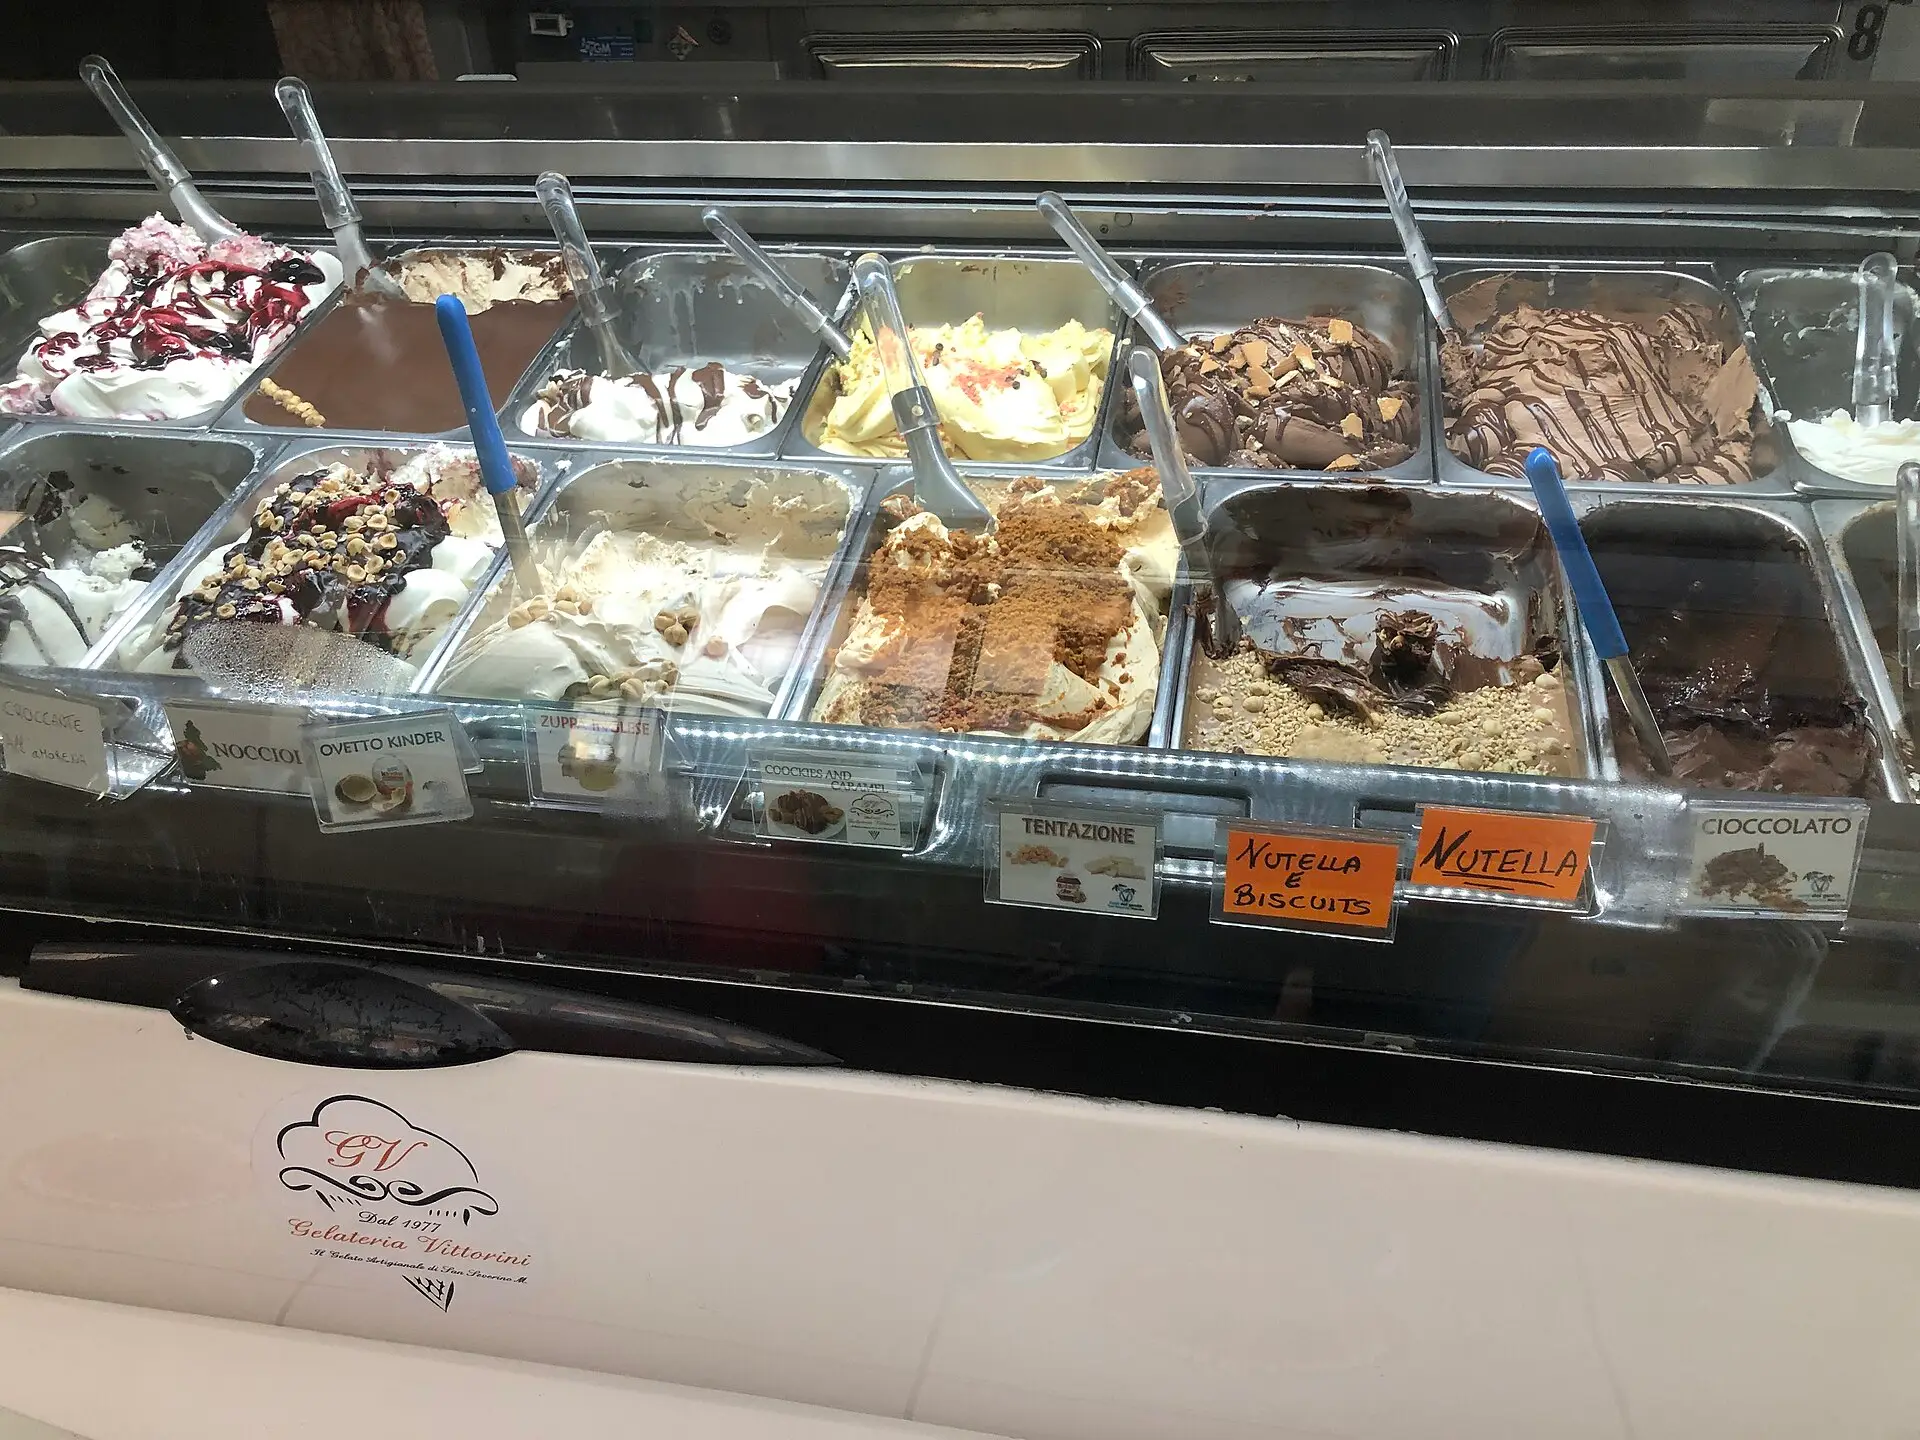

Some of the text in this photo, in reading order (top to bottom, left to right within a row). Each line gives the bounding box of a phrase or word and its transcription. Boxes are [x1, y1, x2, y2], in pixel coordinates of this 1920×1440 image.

[320, 731, 445, 757] OVETTO KINDER
[765, 764, 852, 781] COOCKIES AND
[1022, 816, 1135, 845] TENTAZIONE
[1701, 816, 1851, 836] CIOCCOLATO
[1236, 838, 1361, 873] NUTELLA
[1420, 825, 1578, 876] NUTELLA
[1233, 884, 1371, 916] BISCUITS
[324, 1130, 428, 1172] GV
[358, 1210, 442, 1233] Dal 1977
[288, 1218, 532, 1267] Gelateria Vittorini
[329, 1249, 364, 1262] Gelato
[365, 1255, 426, 1272] Artigianale
[427, 1263, 439, 1273] di
[440, 1264, 464, 1276] San
[467, 1269, 513, 1282] Severino
[513, 1275, 528, 1284] M.
